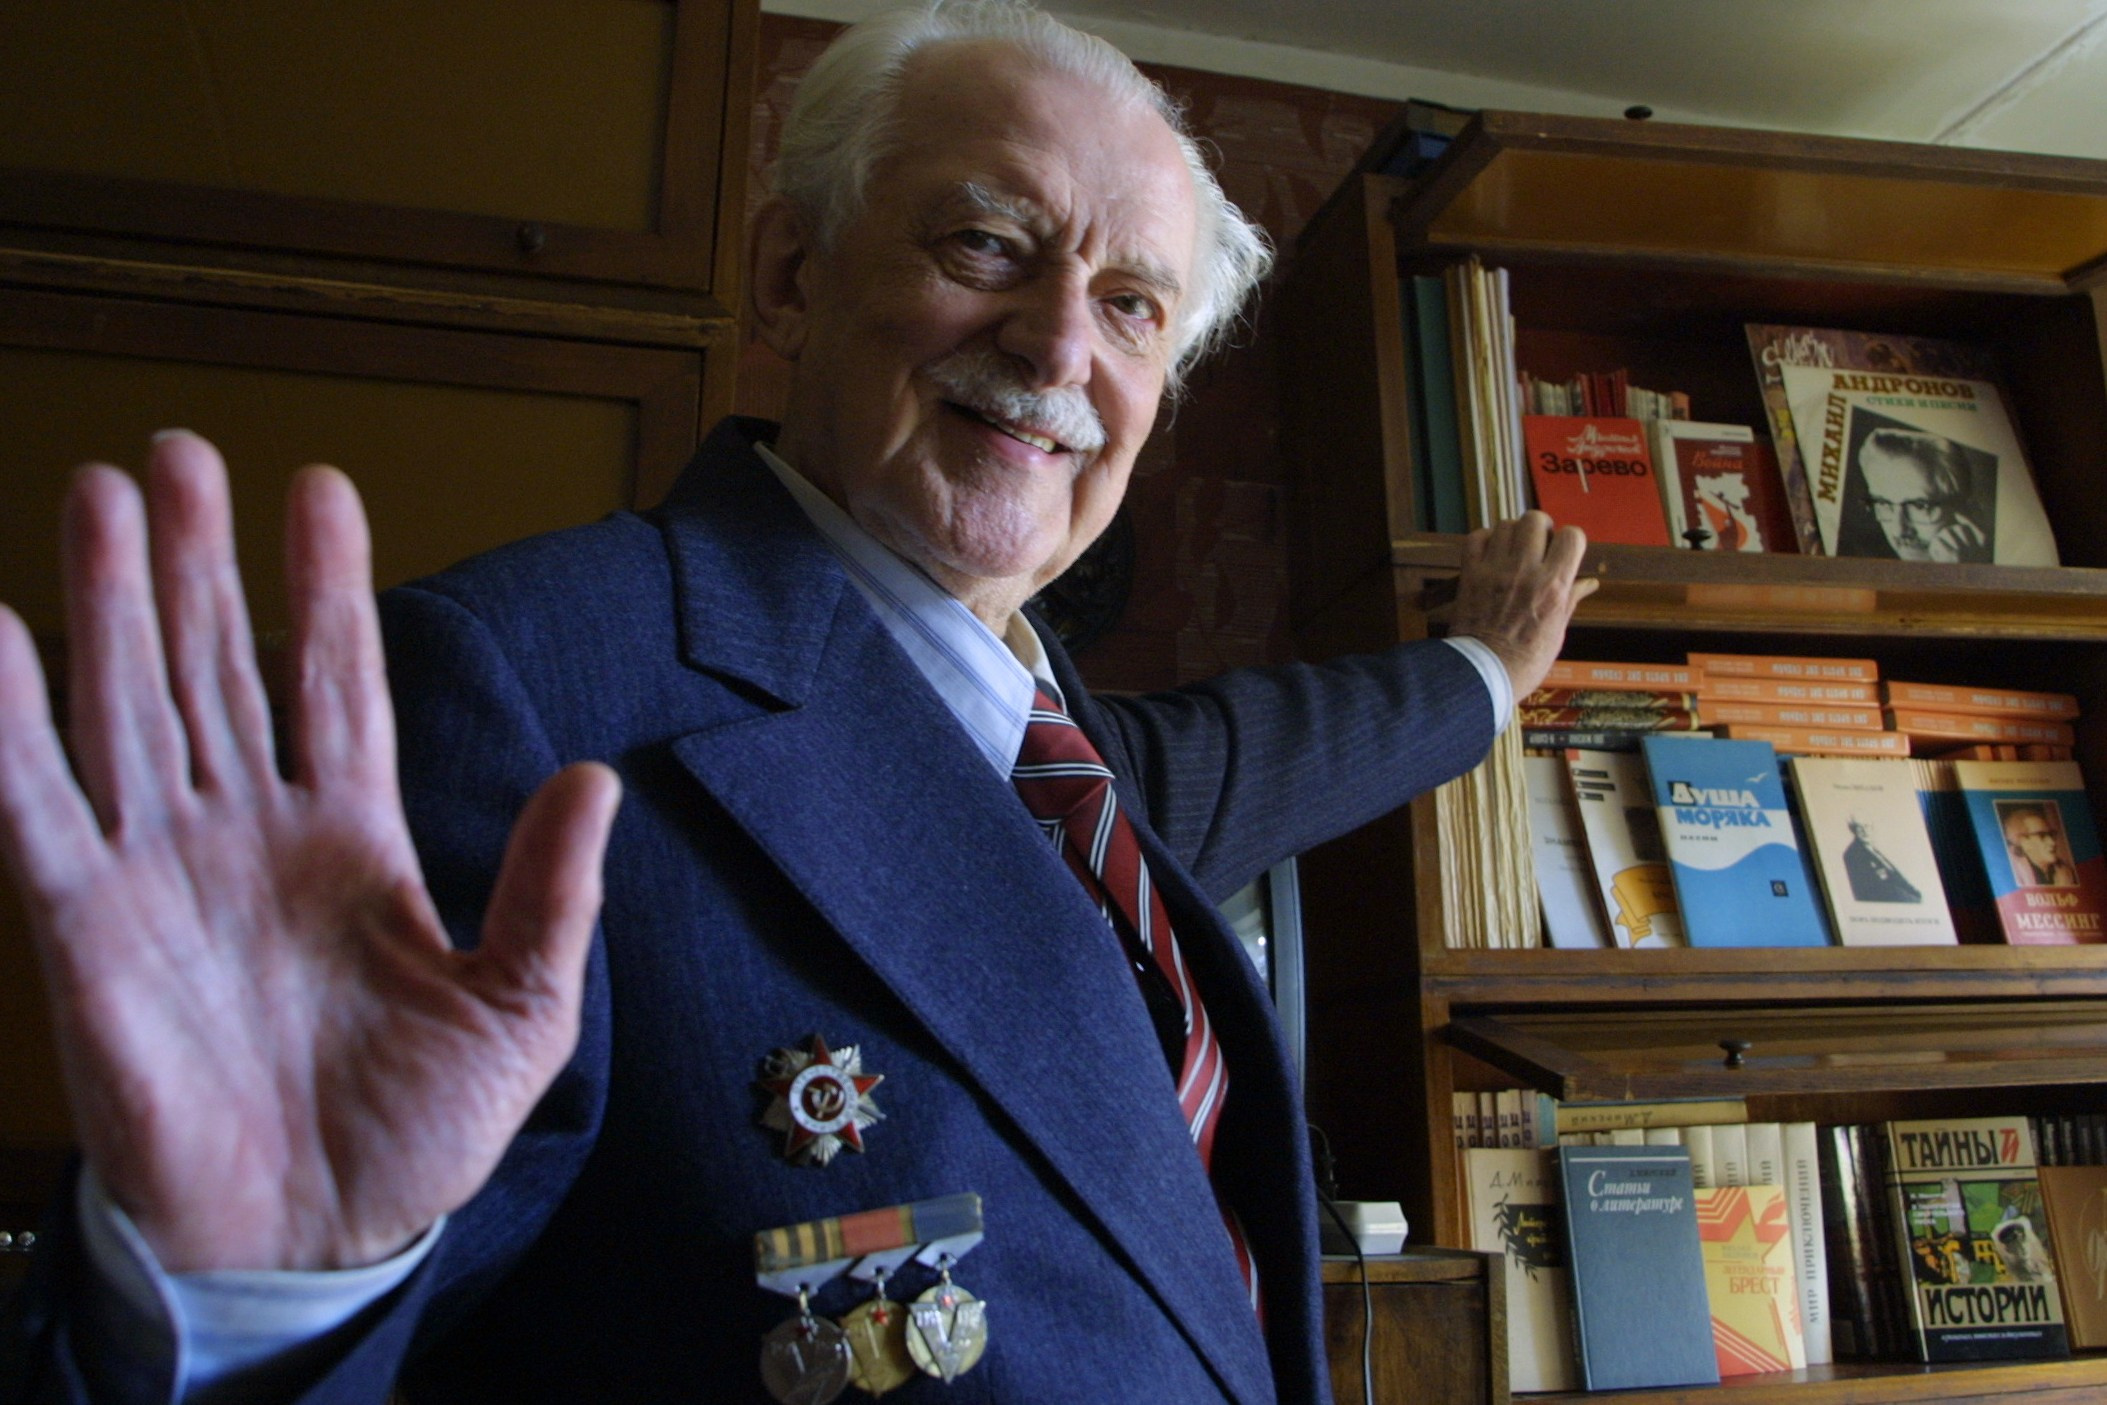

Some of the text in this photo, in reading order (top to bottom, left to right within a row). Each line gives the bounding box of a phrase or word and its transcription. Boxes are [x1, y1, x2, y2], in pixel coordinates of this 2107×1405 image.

[1832, 374, 1975, 399] АНДРОНОВ
[1866, 396, 1915, 408] СТИХИ
[1817, 393, 1848, 504] МИХАИЛ
[1540, 451, 1647, 489] Зарево
[1675, 807, 1772, 829] МОРЯКА
[2024, 893, 2079, 908] ВОЛЬФ
[2014, 912, 2100, 930] МЕССИНГ
[1900, 1129, 1999, 1168] ТАЙНЫ
[1588, 1169, 1651, 1197] Статьи
[1599, 1195, 1684, 1215] литературе
[1796, 1158, 1820, 1325] МИР ПРИКЛЮЧЕНИЙ
[1729, 1276, 1780, 1294] БРЕСТ
[1925, 1285, 2050, 1325] ИСТОРИИ
